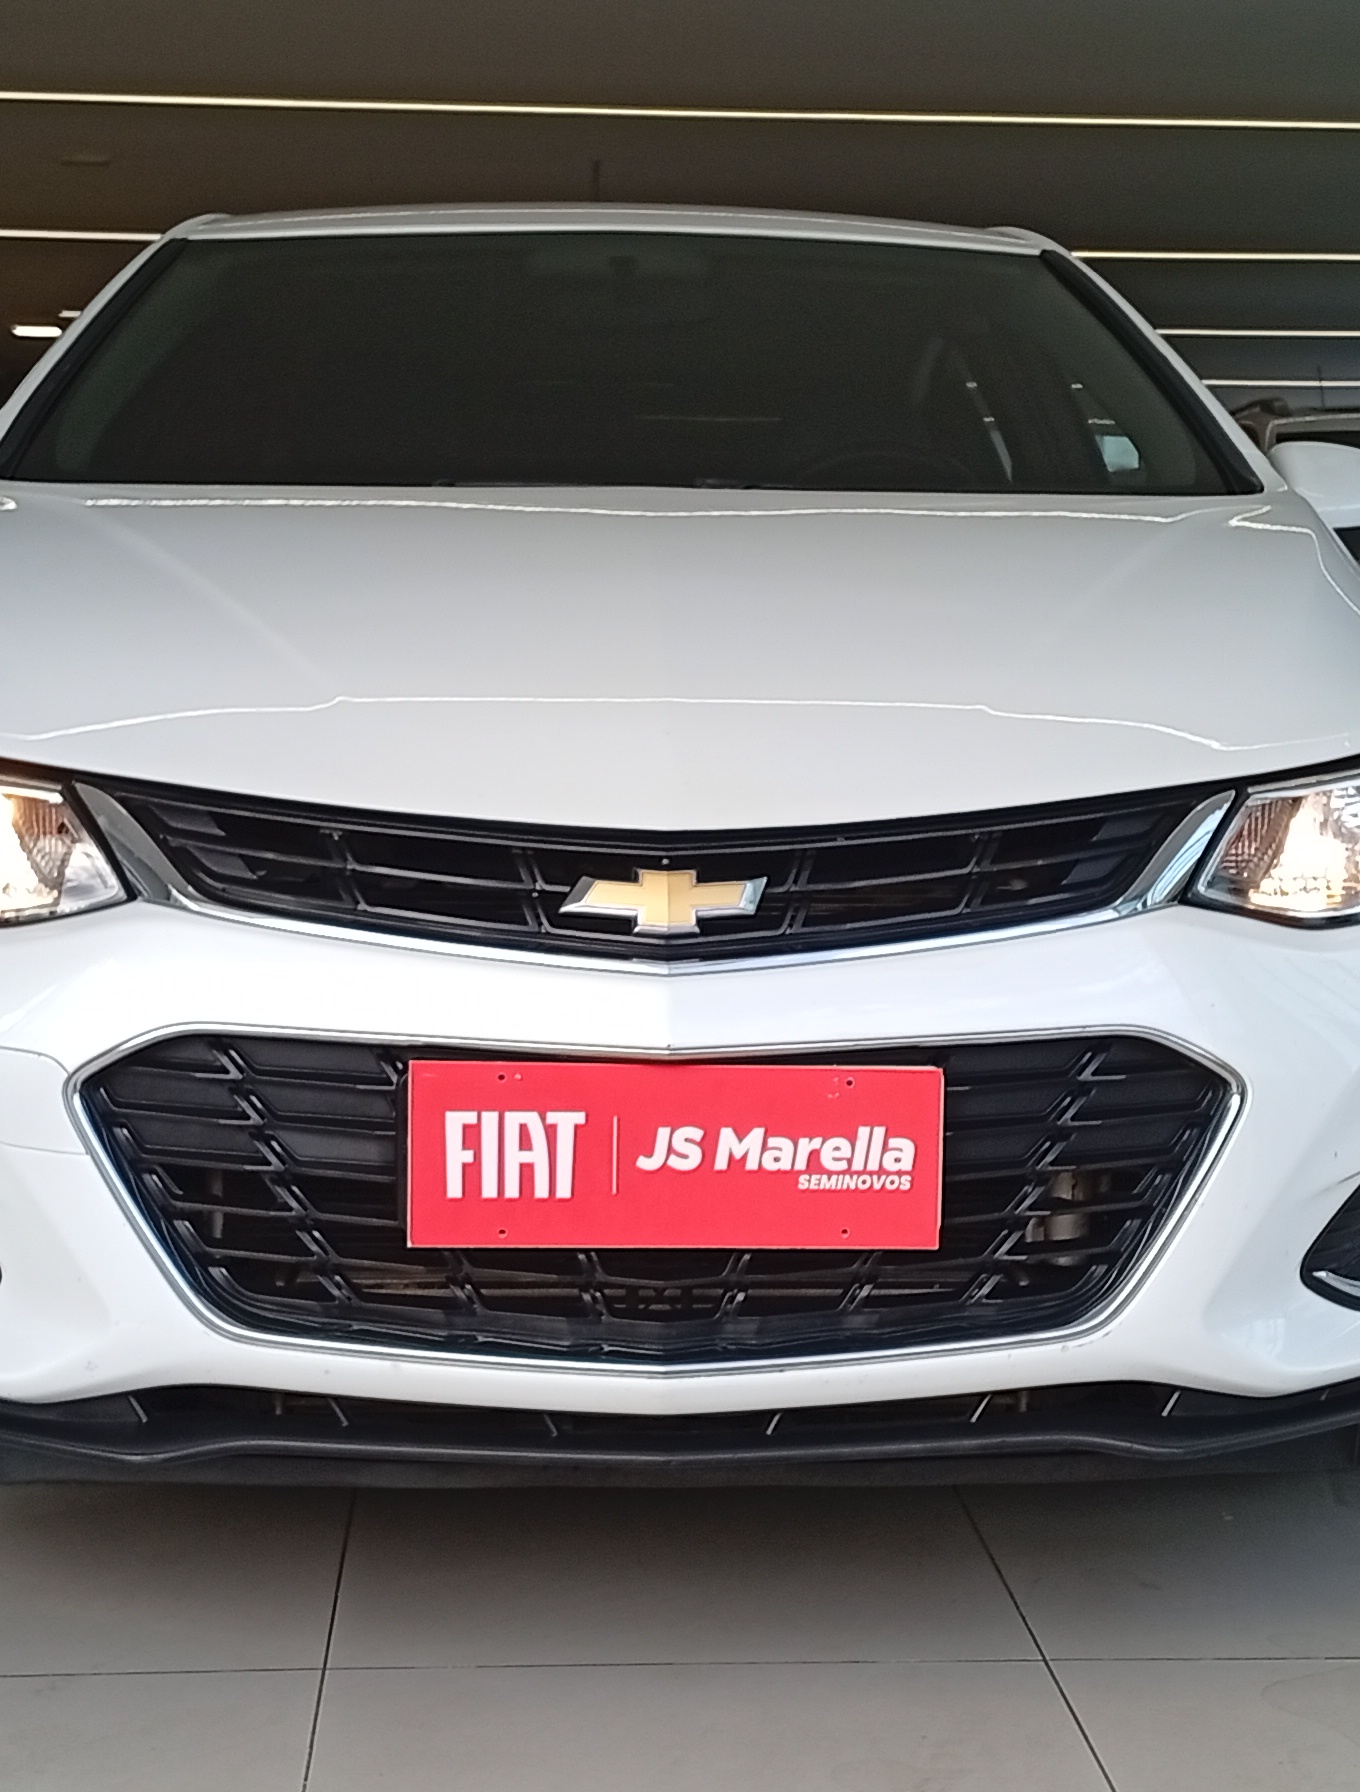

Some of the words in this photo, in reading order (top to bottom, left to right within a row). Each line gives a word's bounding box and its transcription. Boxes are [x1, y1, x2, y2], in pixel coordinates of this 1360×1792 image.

[444, 1110, 586, 1199] FIAT
[635, 1126, 705, 1172] JS
[713, 1126, 916, 1172] Marella
[797, 1173, 912, 1192] SEMINOVOS
